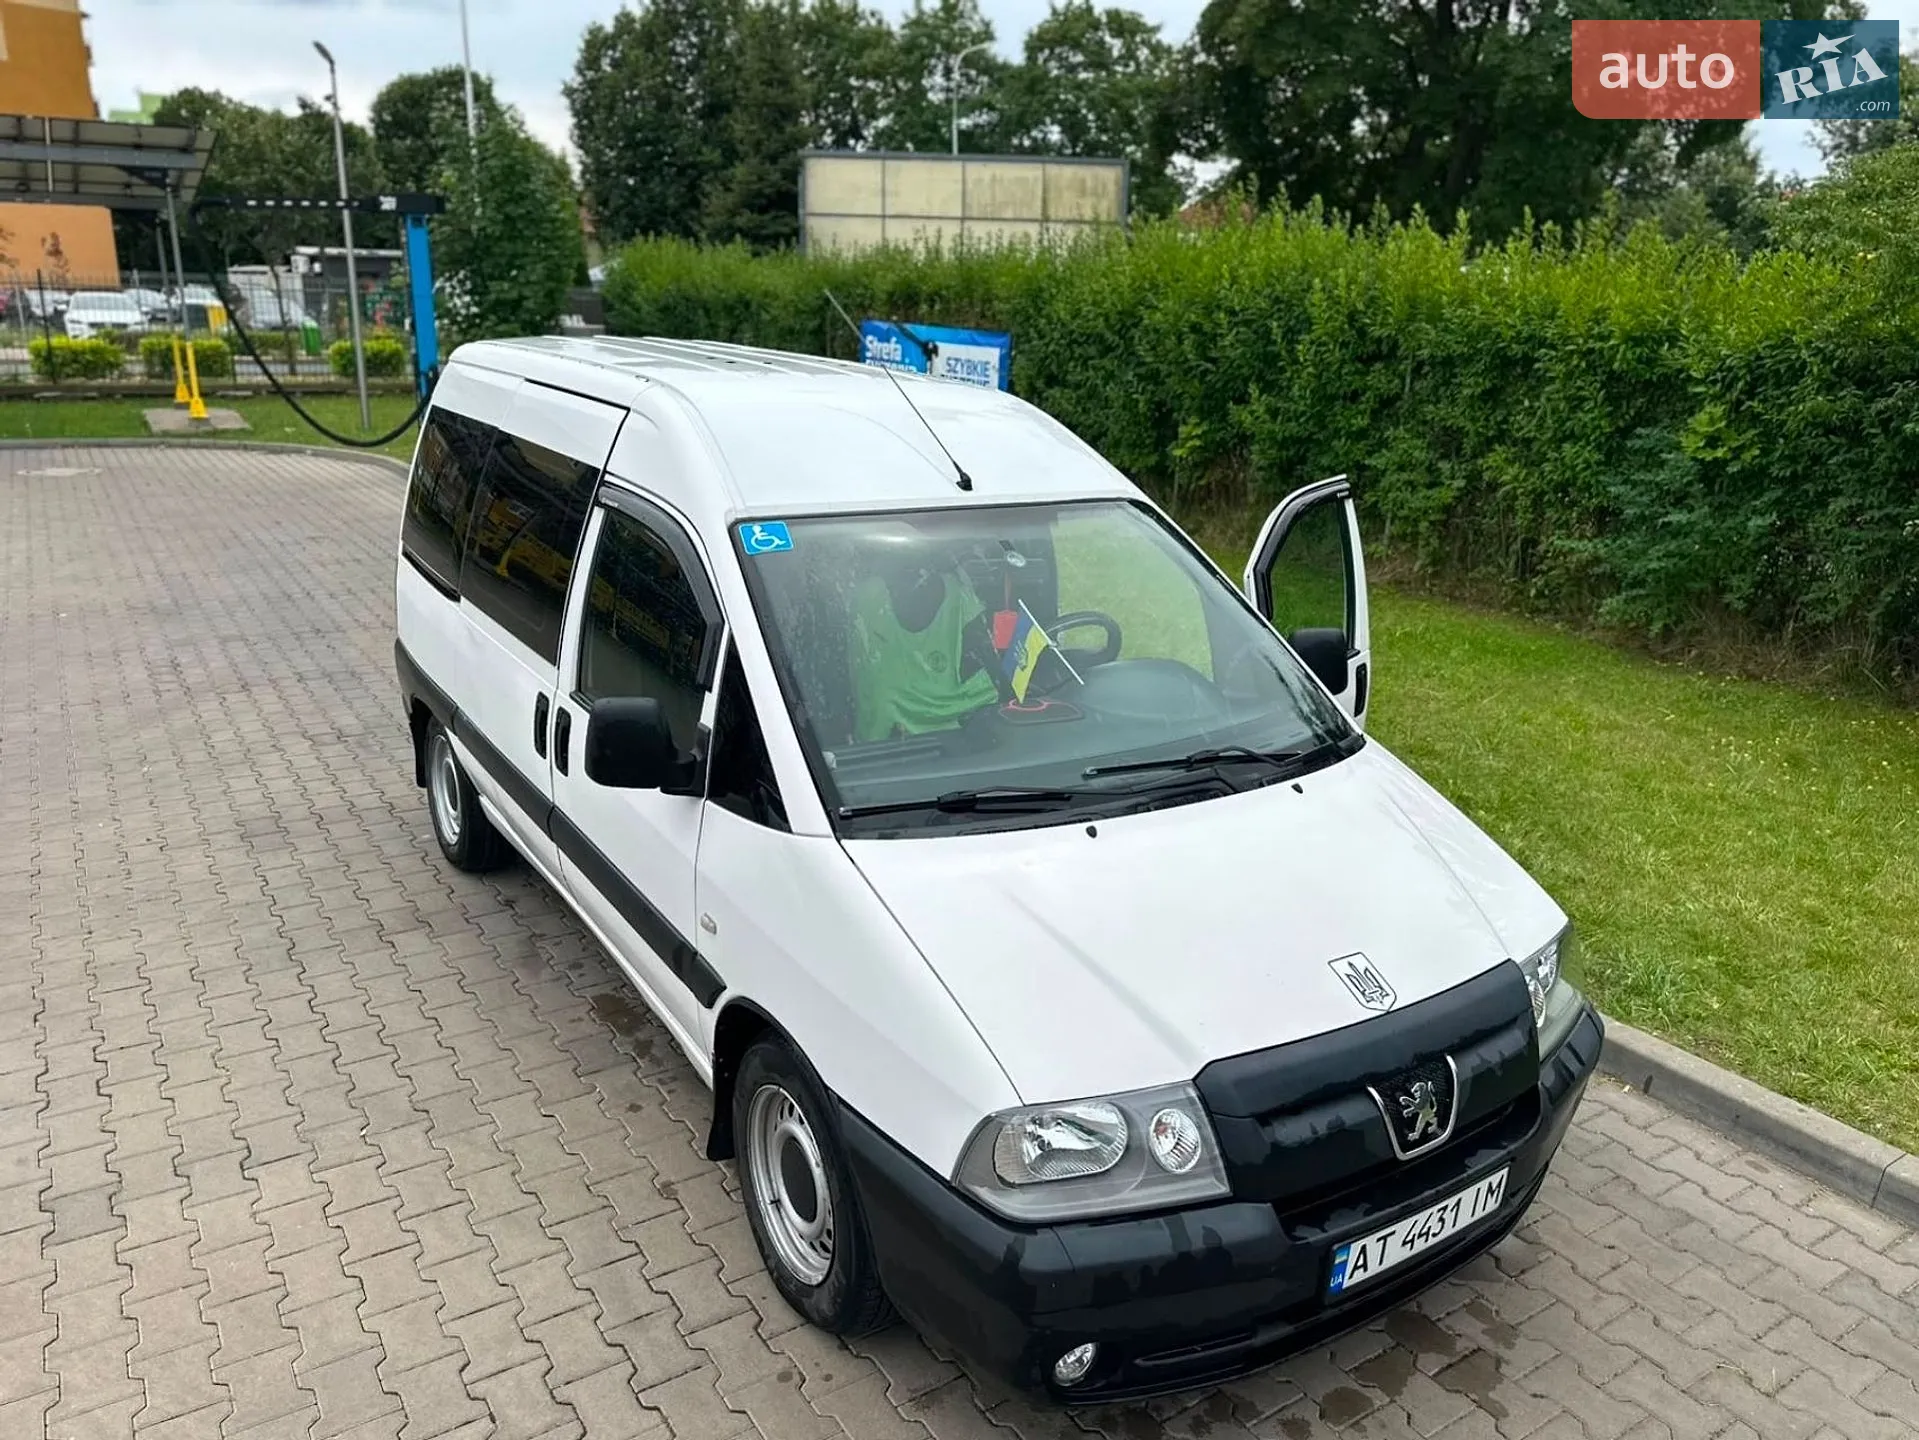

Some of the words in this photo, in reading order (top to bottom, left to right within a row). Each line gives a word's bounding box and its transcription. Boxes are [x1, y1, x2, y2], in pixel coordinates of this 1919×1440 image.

[946, 356, 991, 377] SZYBKIE
[1348, 1230, 1396, 1280] AT
[1401, 1198, 1462, 1250] 4431
[1471, 1174, 1504, 1218] IM
